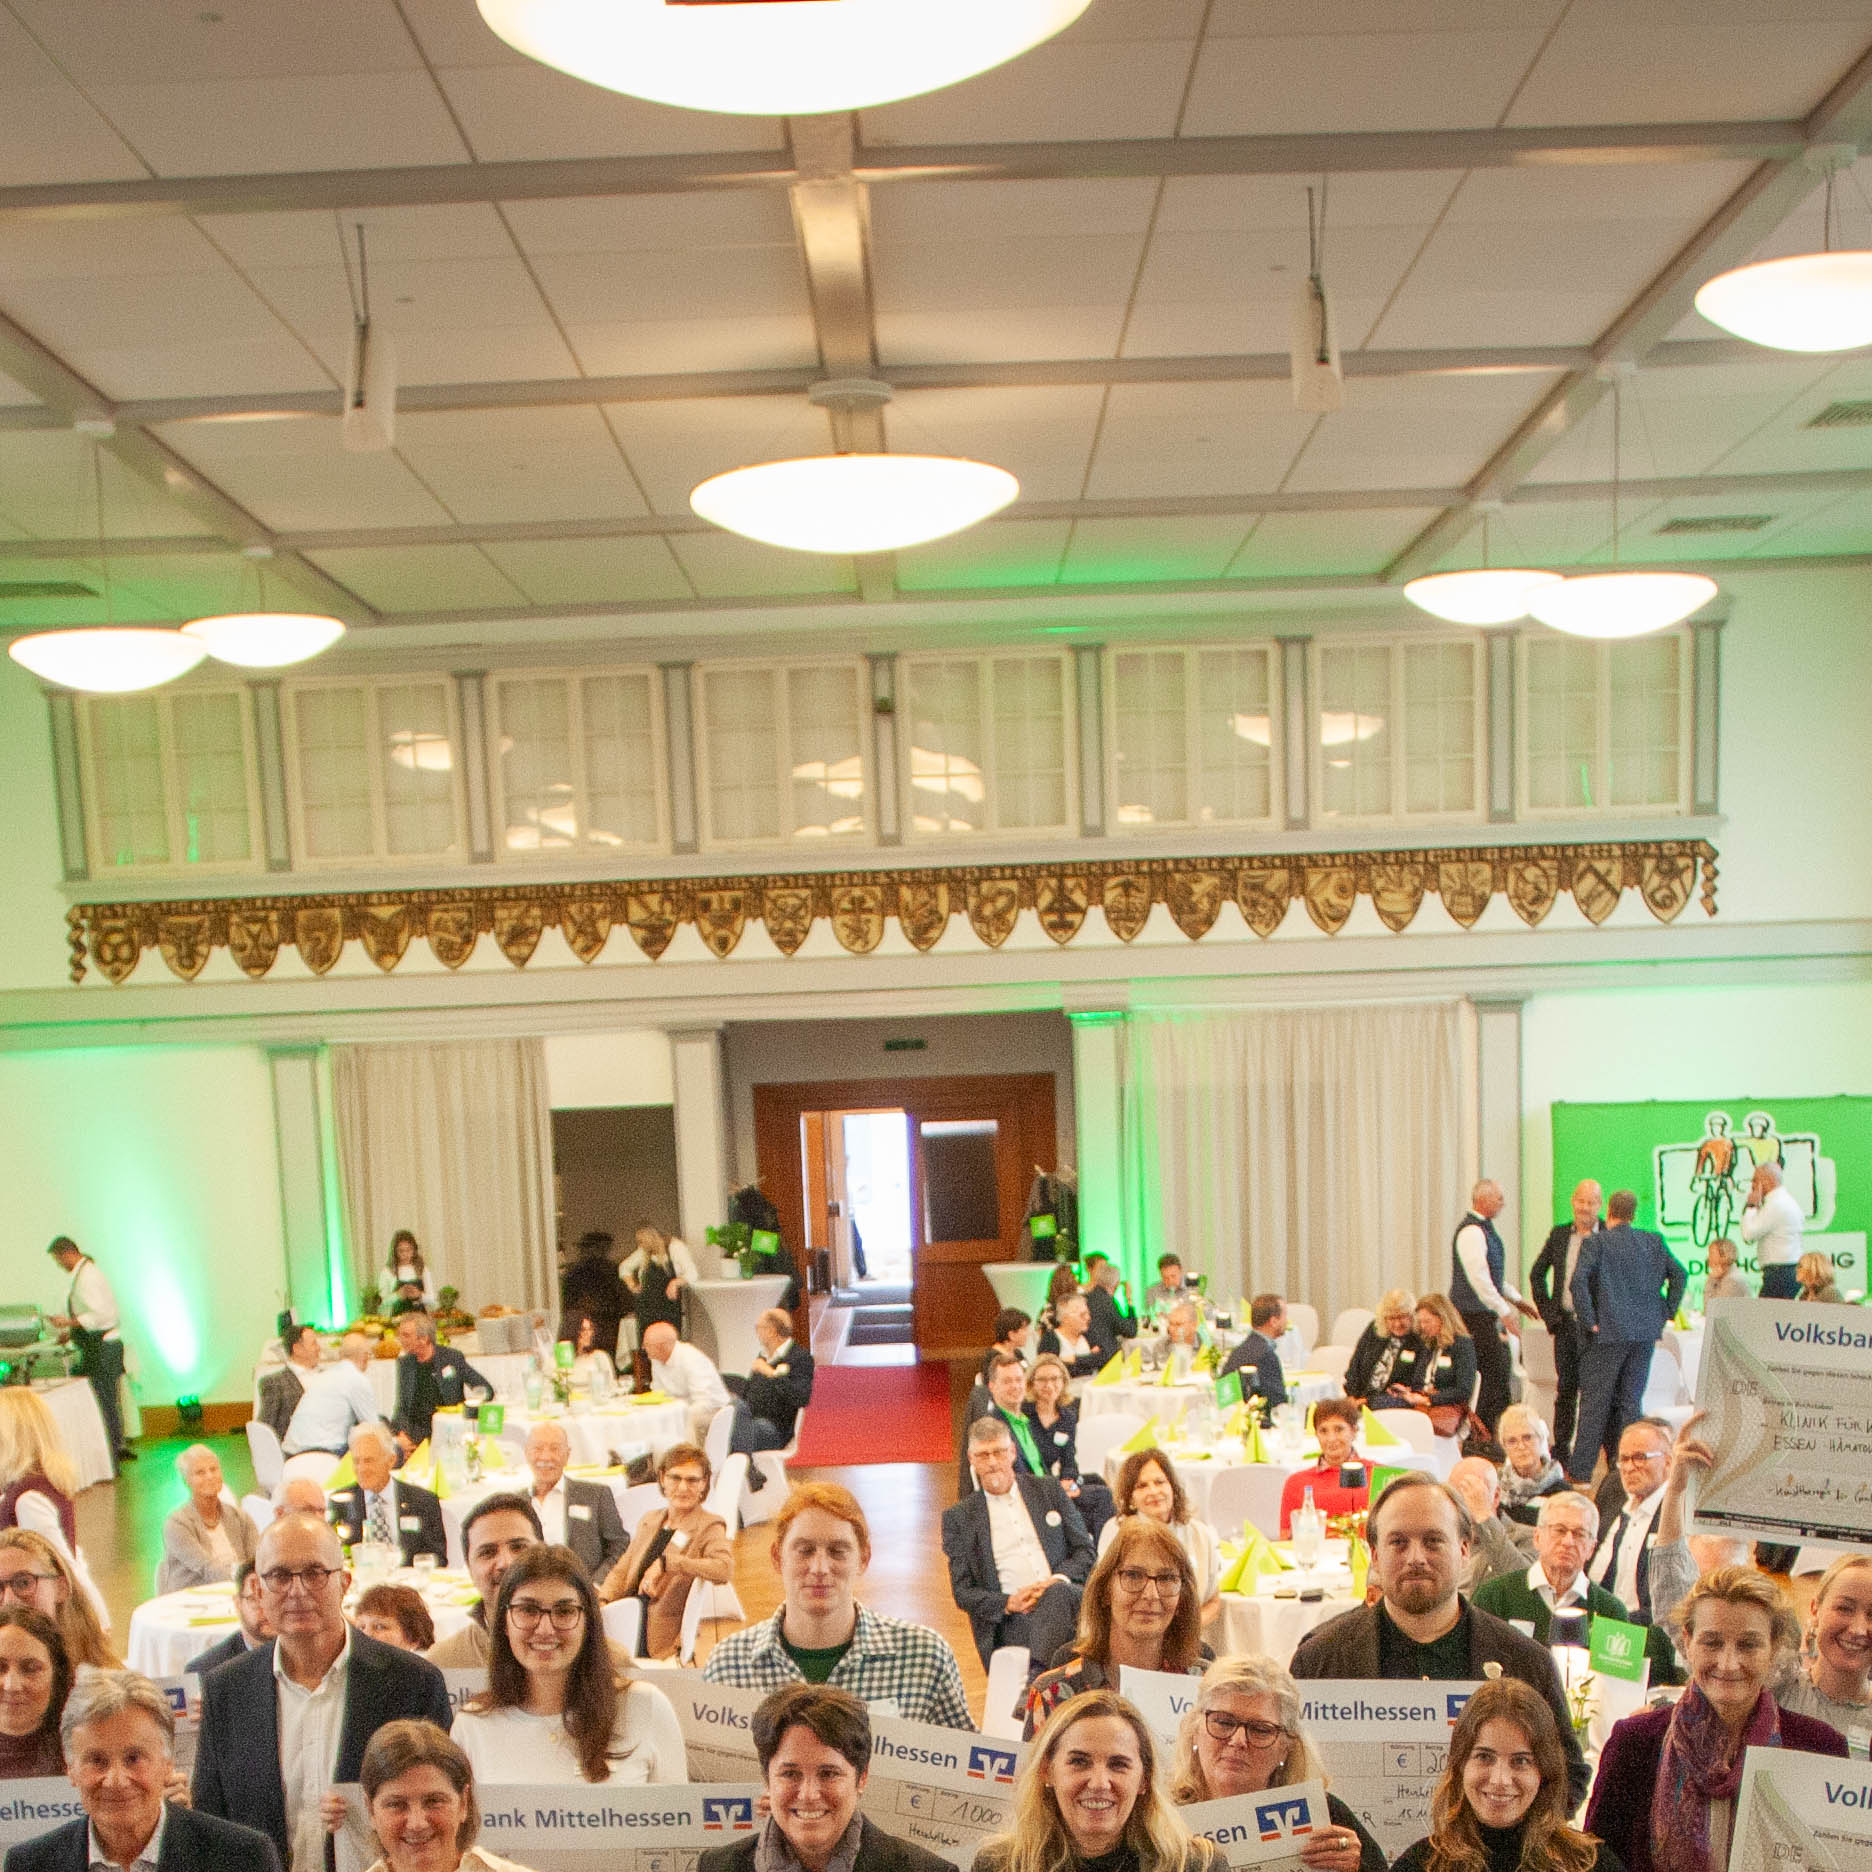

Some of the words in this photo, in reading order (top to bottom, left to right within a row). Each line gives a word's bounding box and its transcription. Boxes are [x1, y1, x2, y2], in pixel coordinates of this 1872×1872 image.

[1778, 1412, 1827, 1428] KLINIK
[1771, 1433, 1816, 1451] ESSEN
[873, 1736, 958, 1769] lhessen
[1397, 1755, 1407, 1767] €
[911, 1796, 921, 1809] €
[535, 1808, 691, 1829] Mittelhessen
